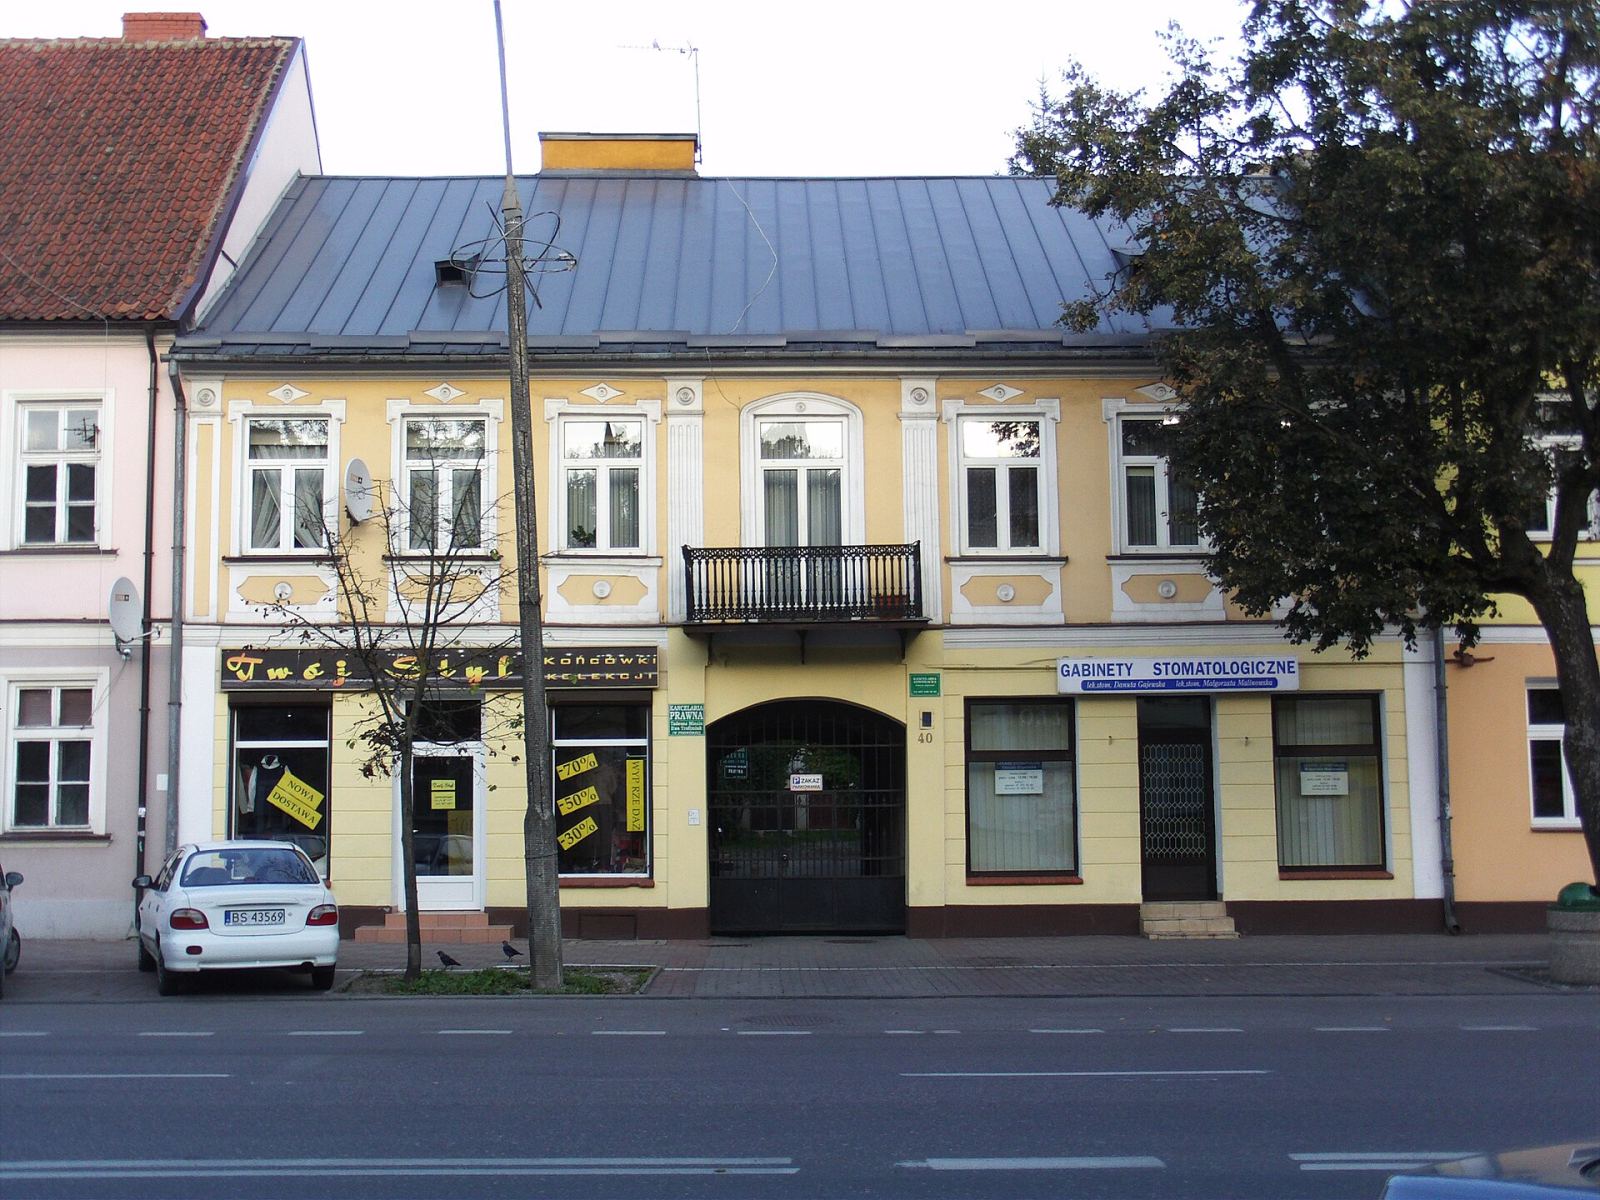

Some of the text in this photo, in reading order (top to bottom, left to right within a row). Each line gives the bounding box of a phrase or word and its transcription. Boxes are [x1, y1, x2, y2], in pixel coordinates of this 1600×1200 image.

[226, 652, 514, 687] Twój Styl
[1060, 660, 1296, 677] GABINETY STOMATOLOGICZNE
[670, 711, 704, 720] PRAWNA
[918, 732, 933, 744] 40
[558, 755, 597, 776] -70%
[288, 780, 314, 802] NOWA
[559, 788, 597, 810] -50%
[272, 792, 315, 824] DOSTAWA
[560, 820, 596, 845] -30%
[232, 912, 284, 923] BS 43569
